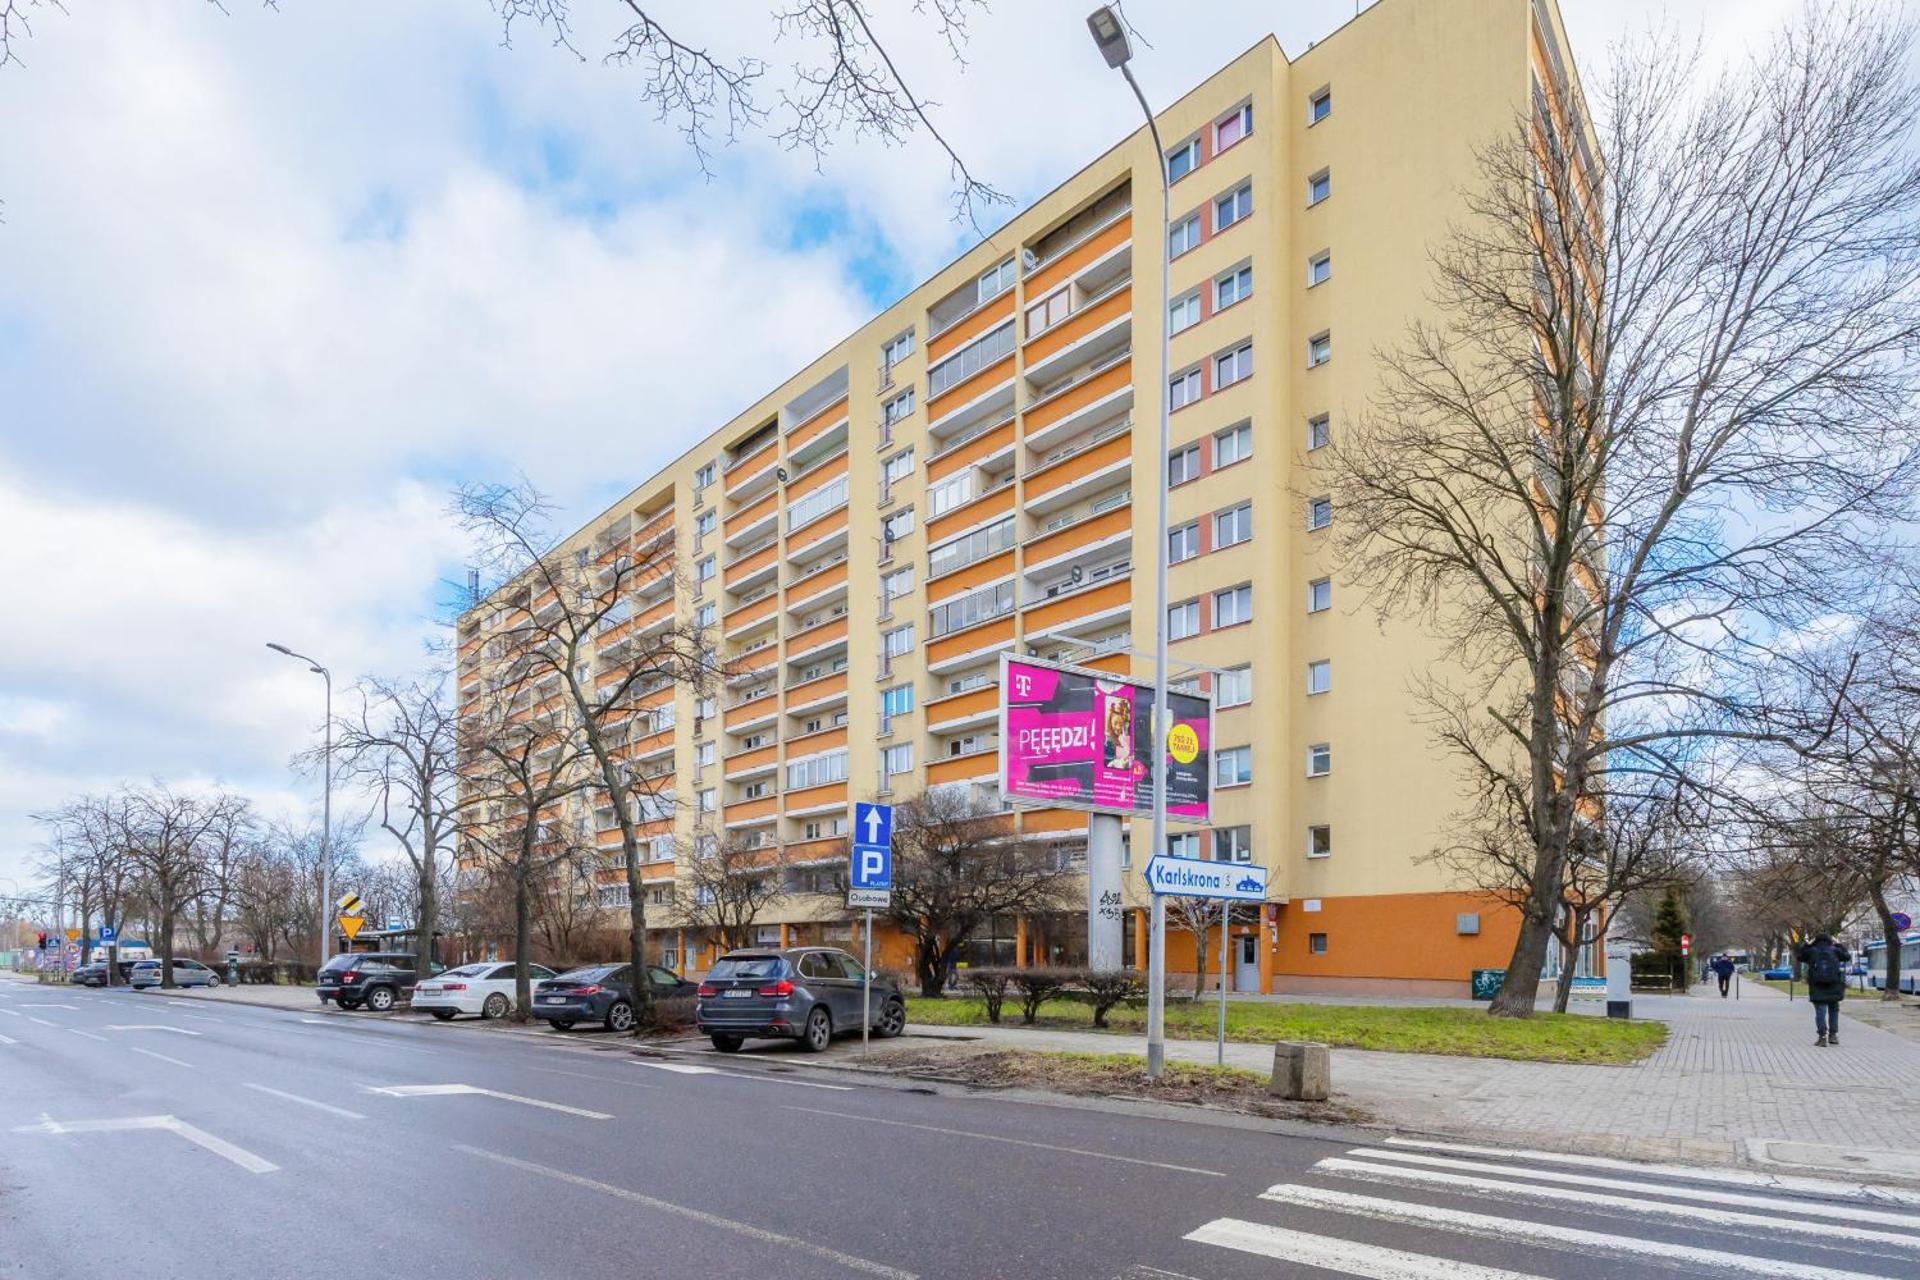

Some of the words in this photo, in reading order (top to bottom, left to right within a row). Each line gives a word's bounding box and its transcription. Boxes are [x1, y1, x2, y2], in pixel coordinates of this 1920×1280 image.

[1015, 674, 1031, 697] T
[861, 851, 883, 882] P
[1156, 864, 1220, 889] Karlskrona
[103, 929, 112, 938] P
